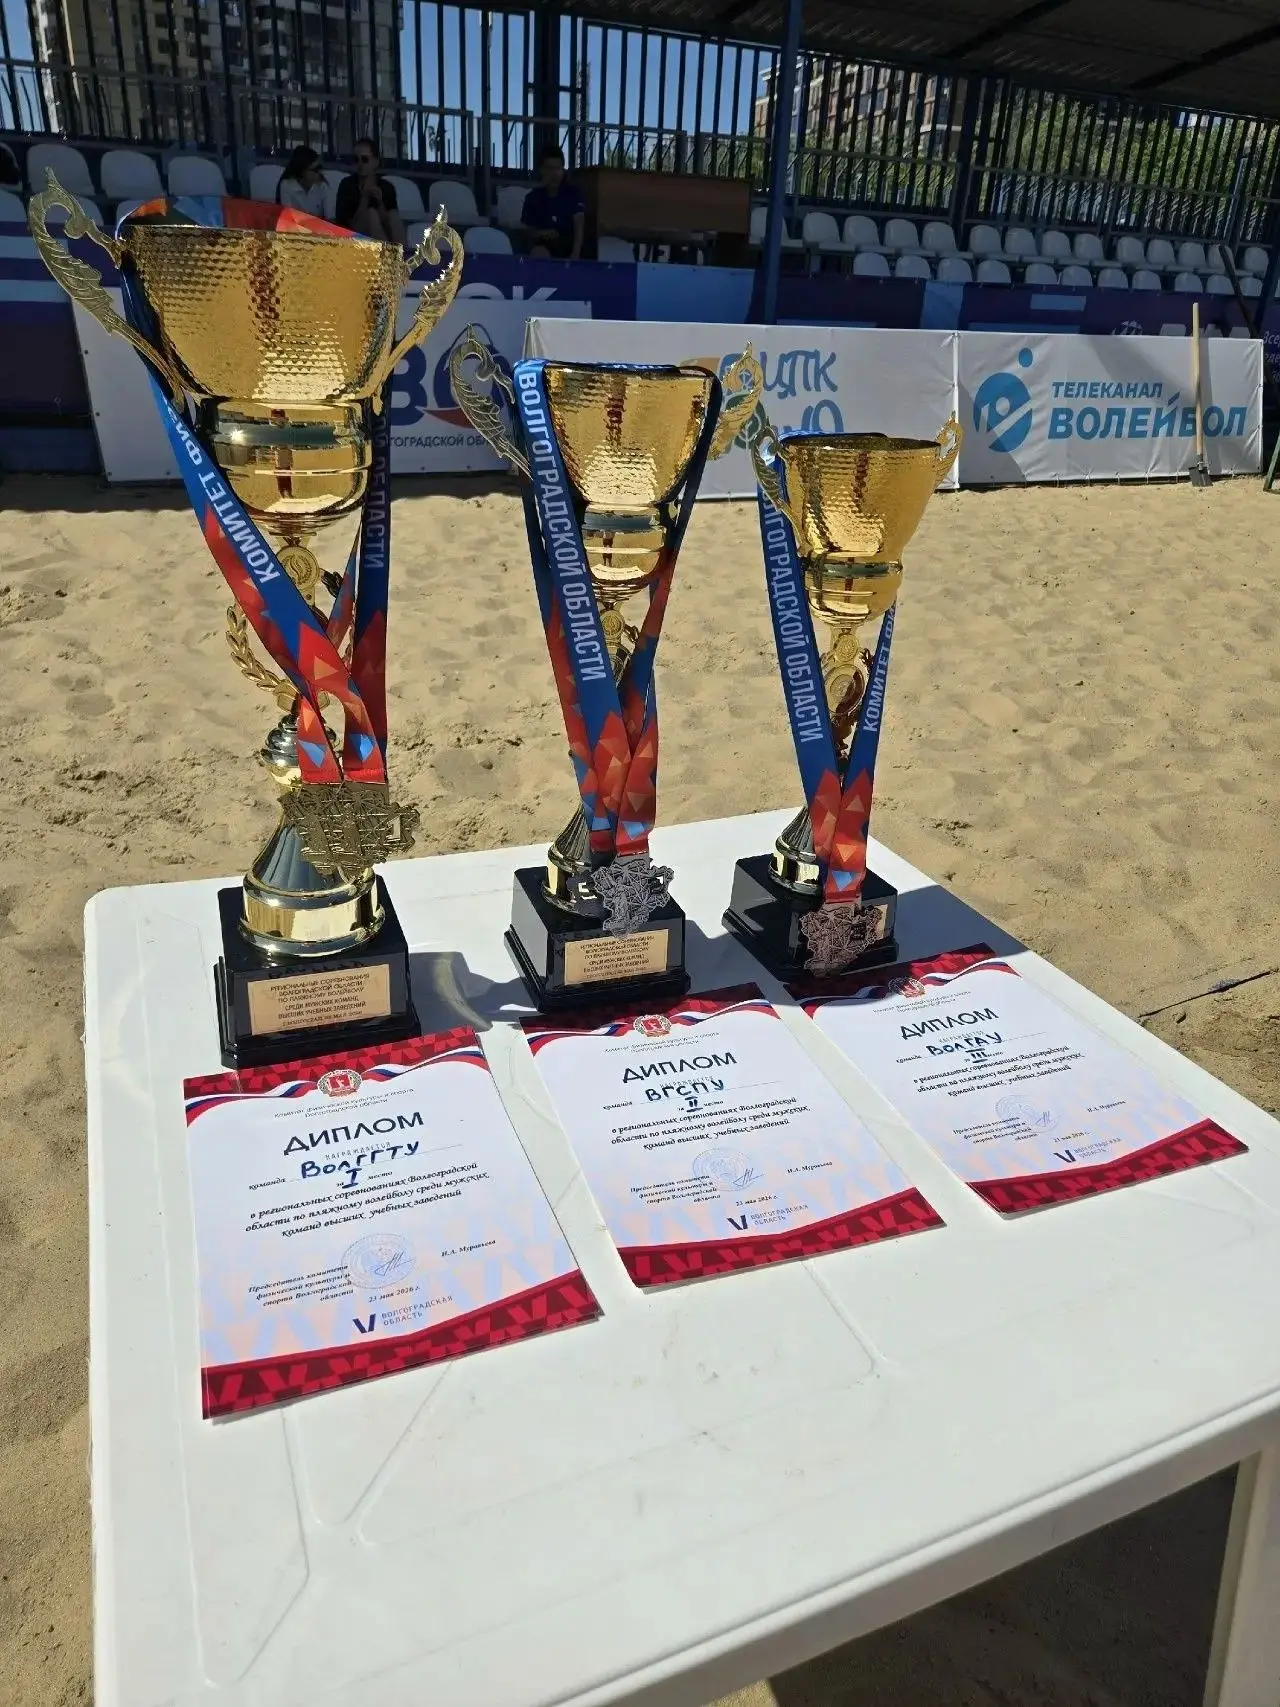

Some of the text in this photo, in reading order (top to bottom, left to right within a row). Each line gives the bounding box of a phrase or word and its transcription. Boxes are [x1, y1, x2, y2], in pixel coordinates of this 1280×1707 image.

[1052, 381, 1163, 398] ТЕЛЕКАНАЛ
[1048, 391, 1248, 440] ВОЛЕЙБОЛ
[200, 471, 280, 584] КОМИТЕТ
[519, 372, 607, 681] ВОЛГОГРАДСКОЙ ОБЛАСТИ
[763, 491, 823, 743] ЛГОГРАДСКОЙ ОБЛАСТИ
[863, 642, 890, 732] КОМИТЕТ
[900, 1008, 999, 1040] ДИПЛОМ
[622, 1052, 737, 1083] ДИПЛОМ
[645, 1079, 725, 1102] ВГСПУ
[283, 1112, 424, 1156] ДИПЛОМ
[611, 1134, 647, 1145] области
[618, 1116, 680, 1134] региональных
[248, 1177, 286, 1190] команда
[258, 1195, 333, 1219] региональных
[334, 1179, 409, 1200] соревнованиях
[408, 1162, 478, 1183] Волгоградской
[245, 1216, 290, 1232] области
[293, 1213, 306, 1221] по
[309, 1201, 362, 1217] пляжному
[365, 1188, 414, 1205] волейболу
[416, 1182, 442, 1194] среди
[282, 1221, 321, 1237] команд
[369, 1201, 414, 1218] учебных
[413, 1189, 462, 1206] заведений
[381, 1296, 453, 1319] ВОЛГОГРАДСКАЯ
[383, 1312, 423, 1326] ОБЛАСТЬ
